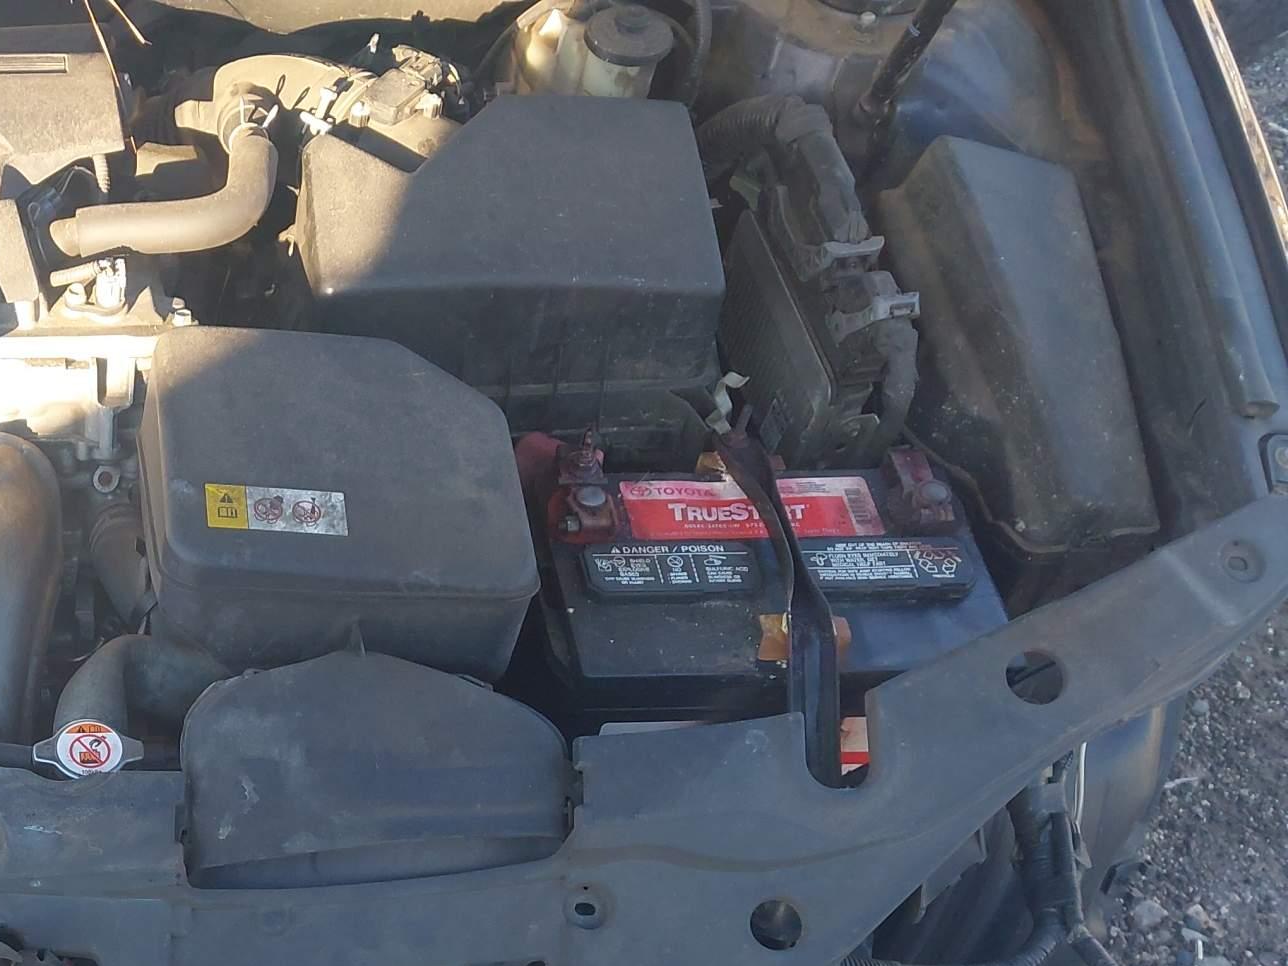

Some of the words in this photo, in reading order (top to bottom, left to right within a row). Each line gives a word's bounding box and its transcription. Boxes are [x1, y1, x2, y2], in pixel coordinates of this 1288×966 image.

[653, 486, 717, 497] TOYOTA
[667, 503, 806, 522] TRUESTT
[622, 545, 669, 554] DANGER
[681, 544, 725, 553] POISON
